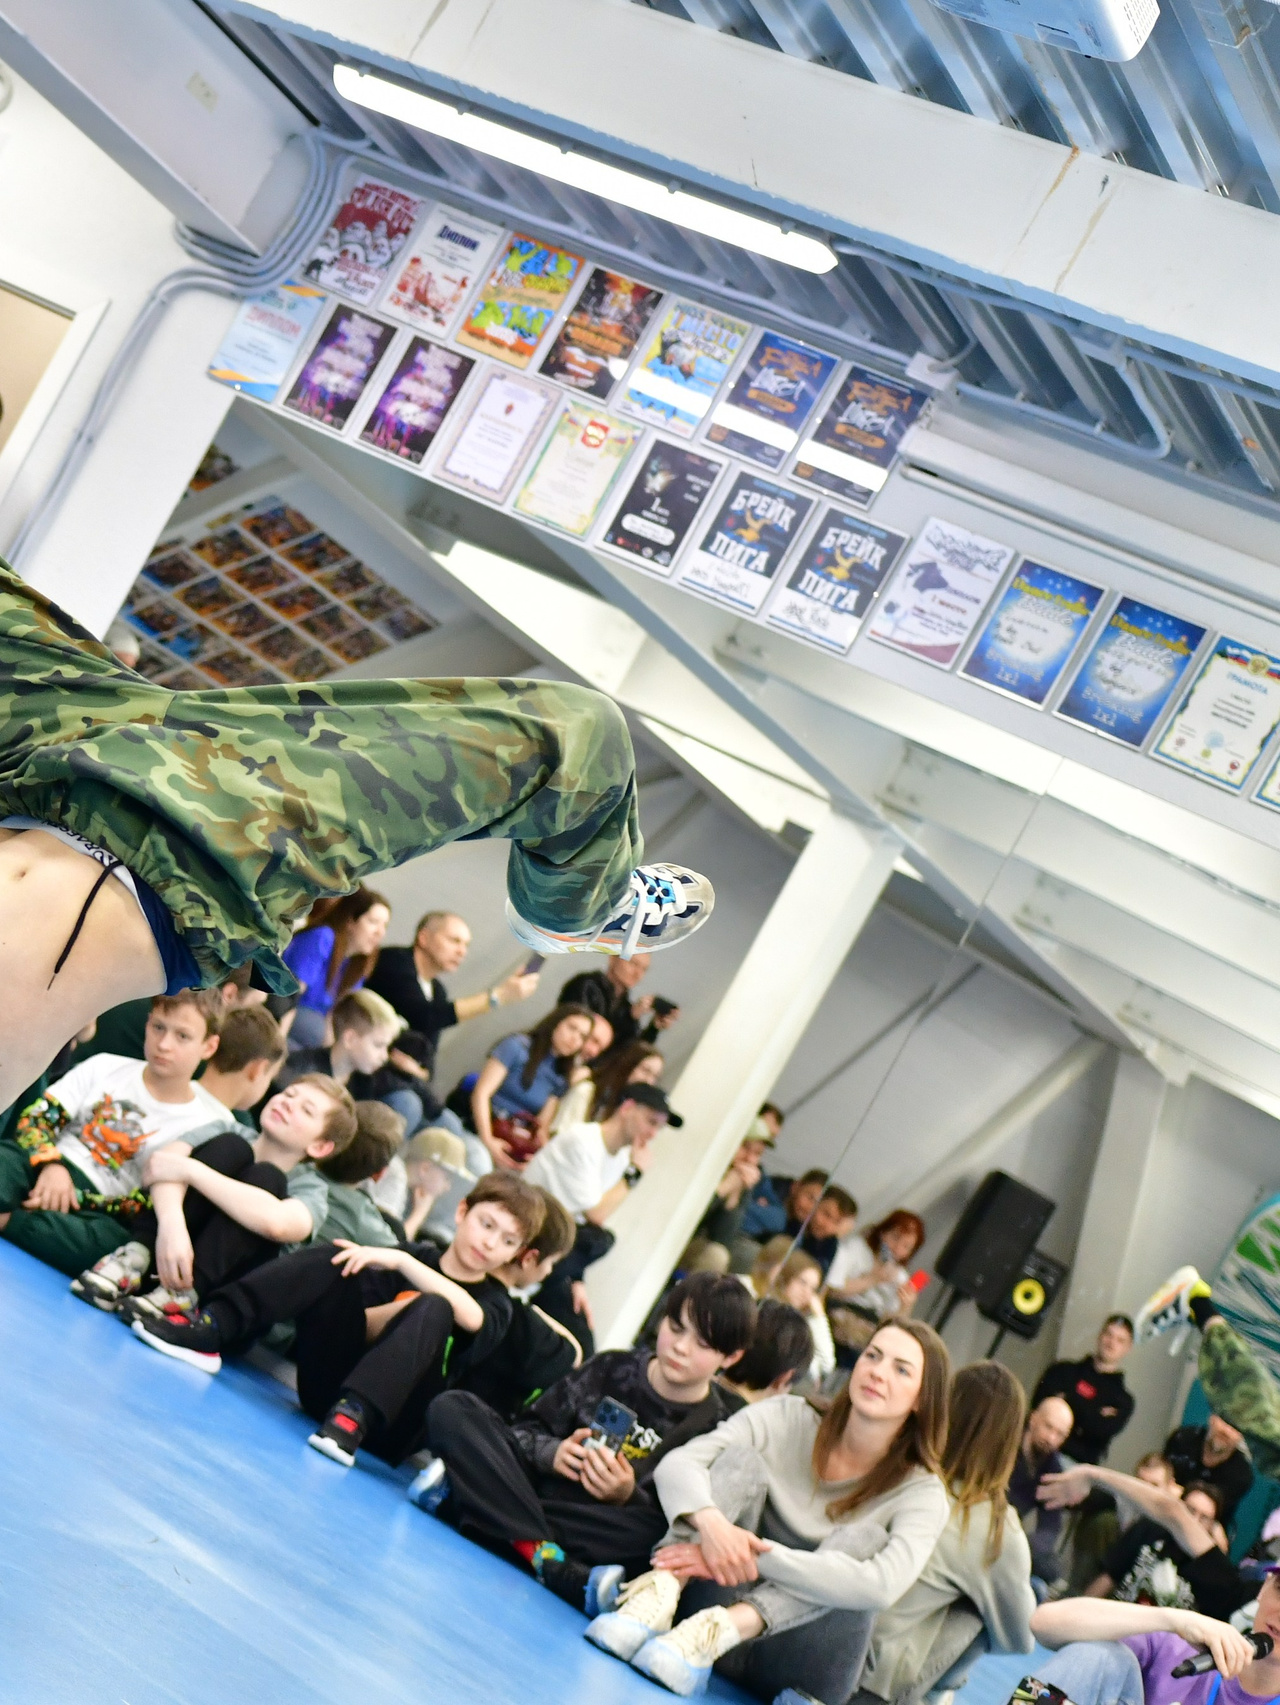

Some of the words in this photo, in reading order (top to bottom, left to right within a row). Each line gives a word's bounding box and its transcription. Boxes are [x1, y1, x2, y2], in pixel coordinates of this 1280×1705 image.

[729, 488, 797, 531] БРЕЙК
[708, 531, 769, 573] ЛИГА
[819, 525, 888, 570] БРЕЙК
[798, 569, 860, 611] ЛИГА
